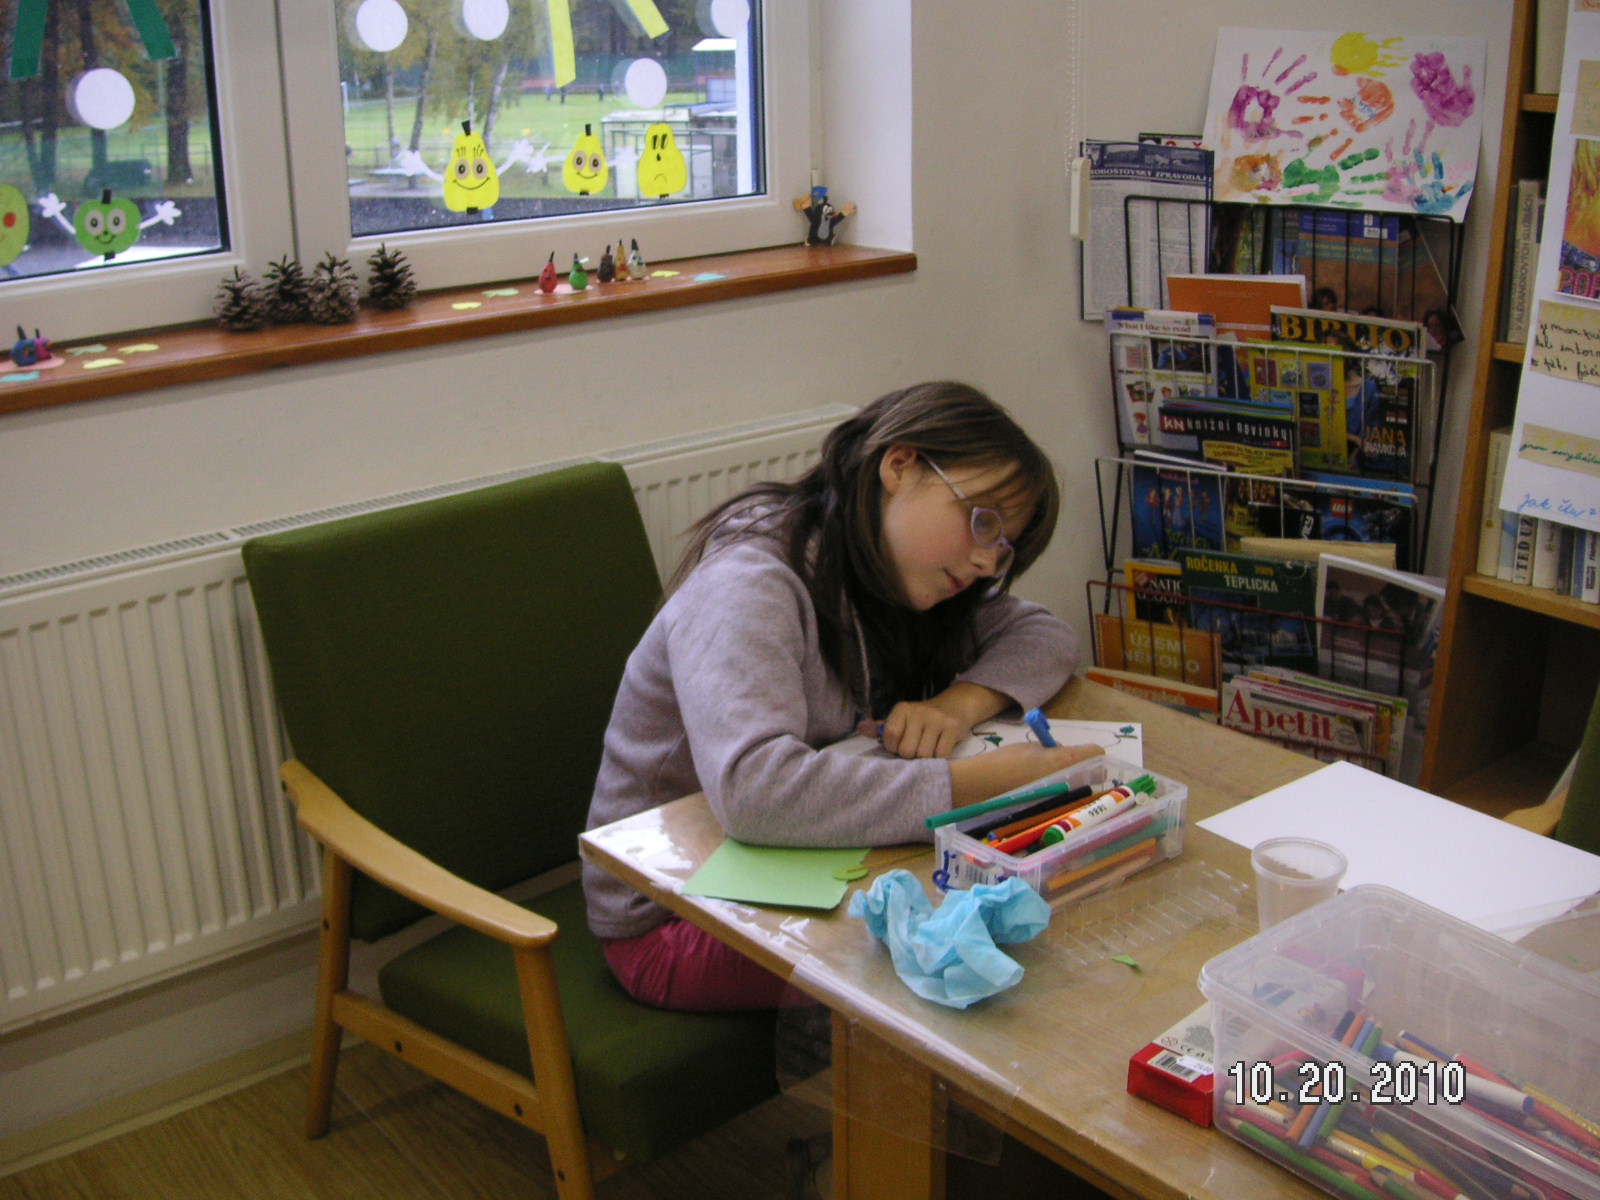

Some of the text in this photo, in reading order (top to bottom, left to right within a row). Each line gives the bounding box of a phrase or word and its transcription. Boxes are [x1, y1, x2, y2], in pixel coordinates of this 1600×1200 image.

[1237, 421, 1288, 441] novinky
[1186, 555, 1239, 576] ROČENKA
[1223, 573, 1279, 593] TEPLICKA
[1226, 689, 1338, 742] Apetit
